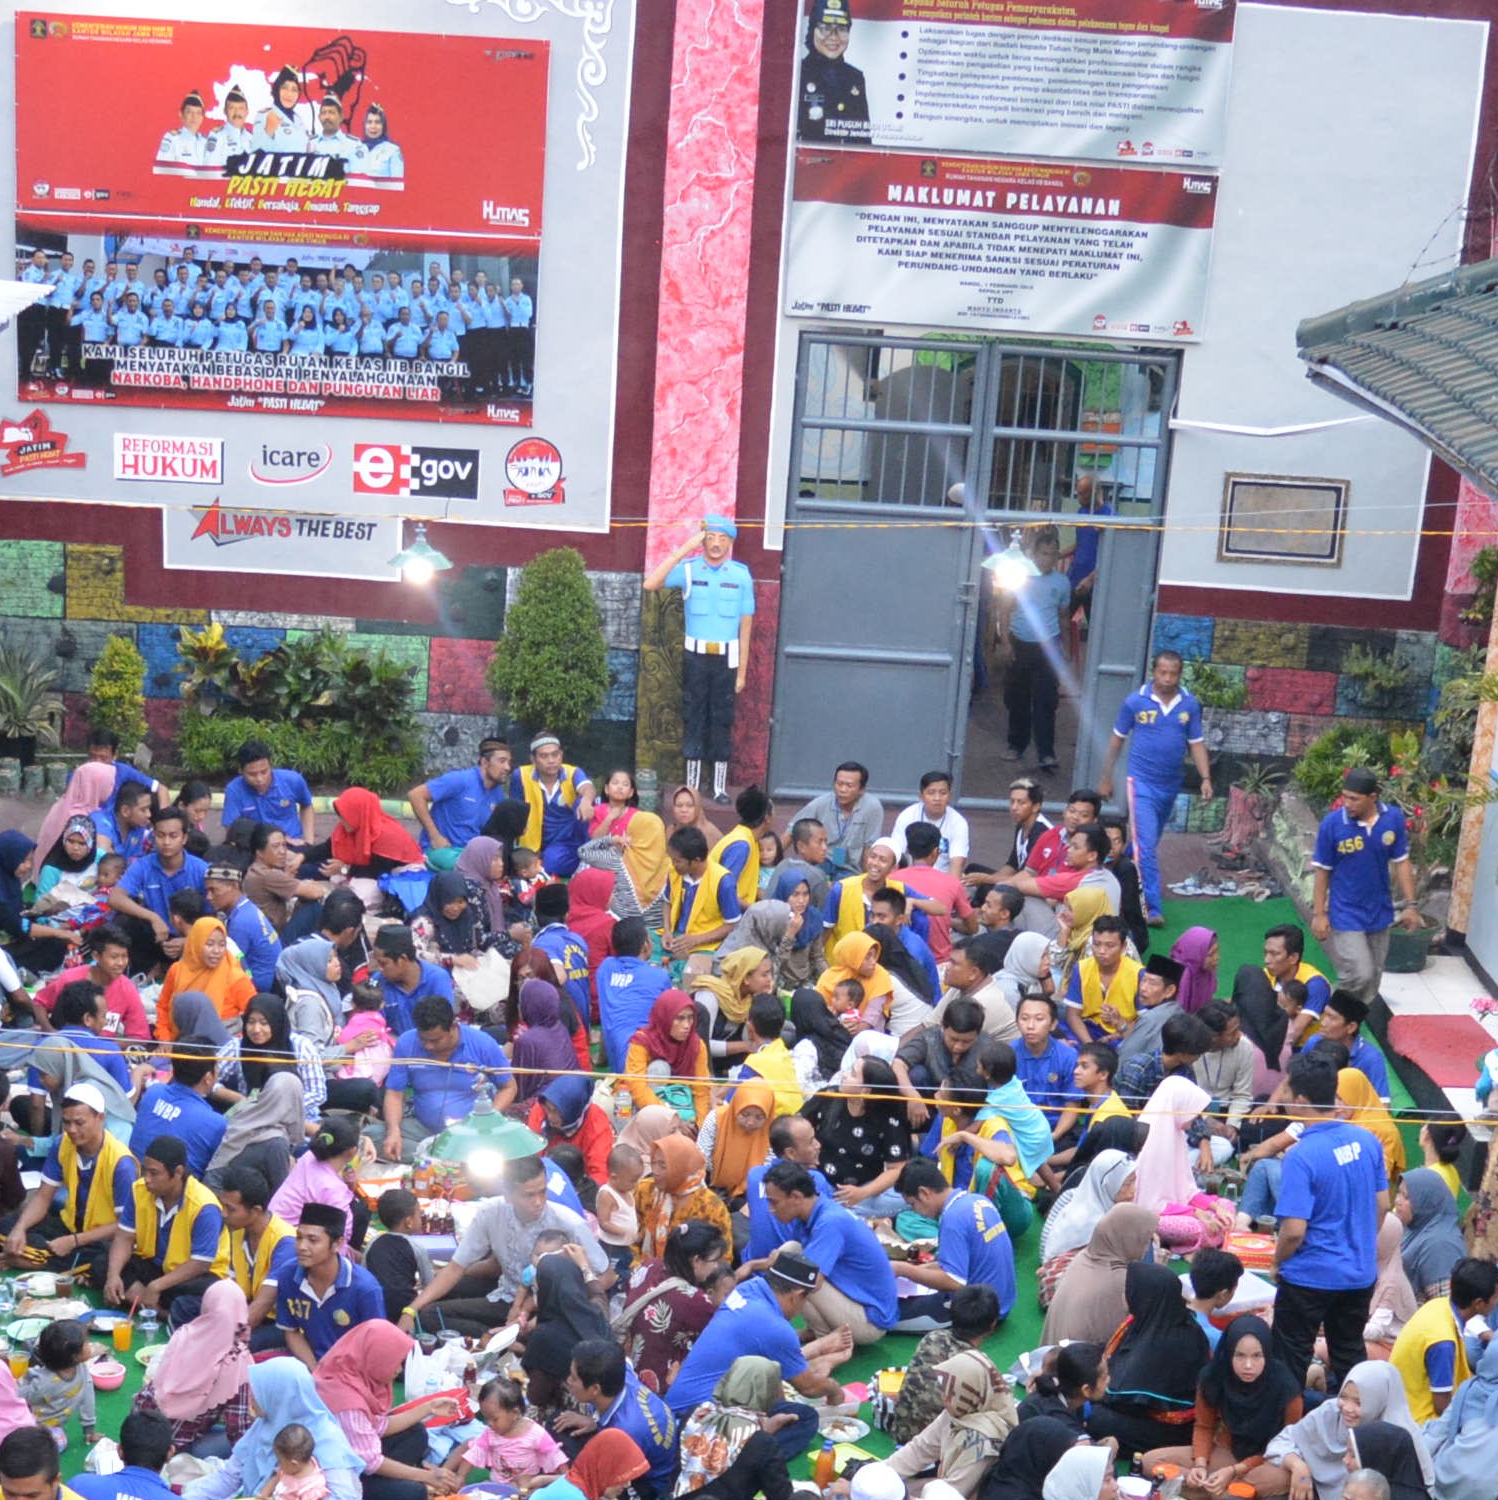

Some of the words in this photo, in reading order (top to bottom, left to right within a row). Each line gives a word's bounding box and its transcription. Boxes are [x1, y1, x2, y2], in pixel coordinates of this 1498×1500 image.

[238, 154, 331, 177] JATIM
[227, 175, 280, 196] PASTI
[284, 178, 346, 199] HEBAT
[887, 184, 997, 208] MAKLUMAT
[1006, 192, 1121, 216] PELAYANAN
[868, 225, 925, 235] PELAYANAN
[928, 229, 963, 238] SESUAI
[966, 231, 1011, 241] STANDAR
[1014, 234, 1070, 245] PELAYANAN
[1074, 238, 1100, 247] YANG
[1103, 240, 1133, 249] TELAH
[923, 217, 989, 229] MENYATAKAN
[992, 221, 1039, 231] SANGGUP
[1042, 224, 1148, 238] MENYELENGGARAKAN
[856, 235, 917, 246] DITETAPKAN
[920, 240, 941, 248] DAN
[943, 241, 984, 251] APABILA
[986, 243, 1016, 253] TIDAK
[1018, 245, 1067, 256] MENEPATI
[1070, 249, 1123, 260] MAKLUMAT
[878, 248, 902, 257] KAMI
[905, 250, 928, 258] SIAP
[930, 251, 982, 262] MENERIMA
[985, 254, 1021, 264] SANKSI
[1024, 257, 1059, 267] SESUAI
[1062, 260, 1120, 271] PERATURAN
[897, 261, 1016, 275] PERUNDANG-UNDANGAN
[1019, 268, 1046, 277] YANG
[82, 345, 124, 359] KAMI
[129, 347, 201, 362] SELURUH
[203, 351, 272, 366] PETUGAS
[278, 355, 328, 368] RUTAN
[334, 358, 381, 372] KELAS
[387, 360, 408, 373] IIB
[414, 362, 470, 376] BANGIL
[116, 360, 213, 375] MENYATAKAN
[216, 365, 263, 378] BEBAS
[266, 367, 298, 379] DARI
[303, 369, 437, 386] PENYALAHGUNAAN
[111, 372, 188, 388] NARKOBA,
[191, 376, 284, 392] HANDPHONE
[288, 381, 321, 394] DAN
[323, 383, 402, 398] PUNGUTAN
[406, 386, 441, 400] LIAR
[19, 441, 51, 455] JATIM
[122, 437, 213, 457] REFORMASI
[262, 444, 321, 468] icare
[121, 453, 218, 479] HUKUM
[190, 496, 292, 541] ALWAYS
[295, 518, 332, 538] THE
[333, 520, 377, 541] BEST
[1337, 836, 1364, 854] 456
[152, 1098, 182, 1122] WBP
